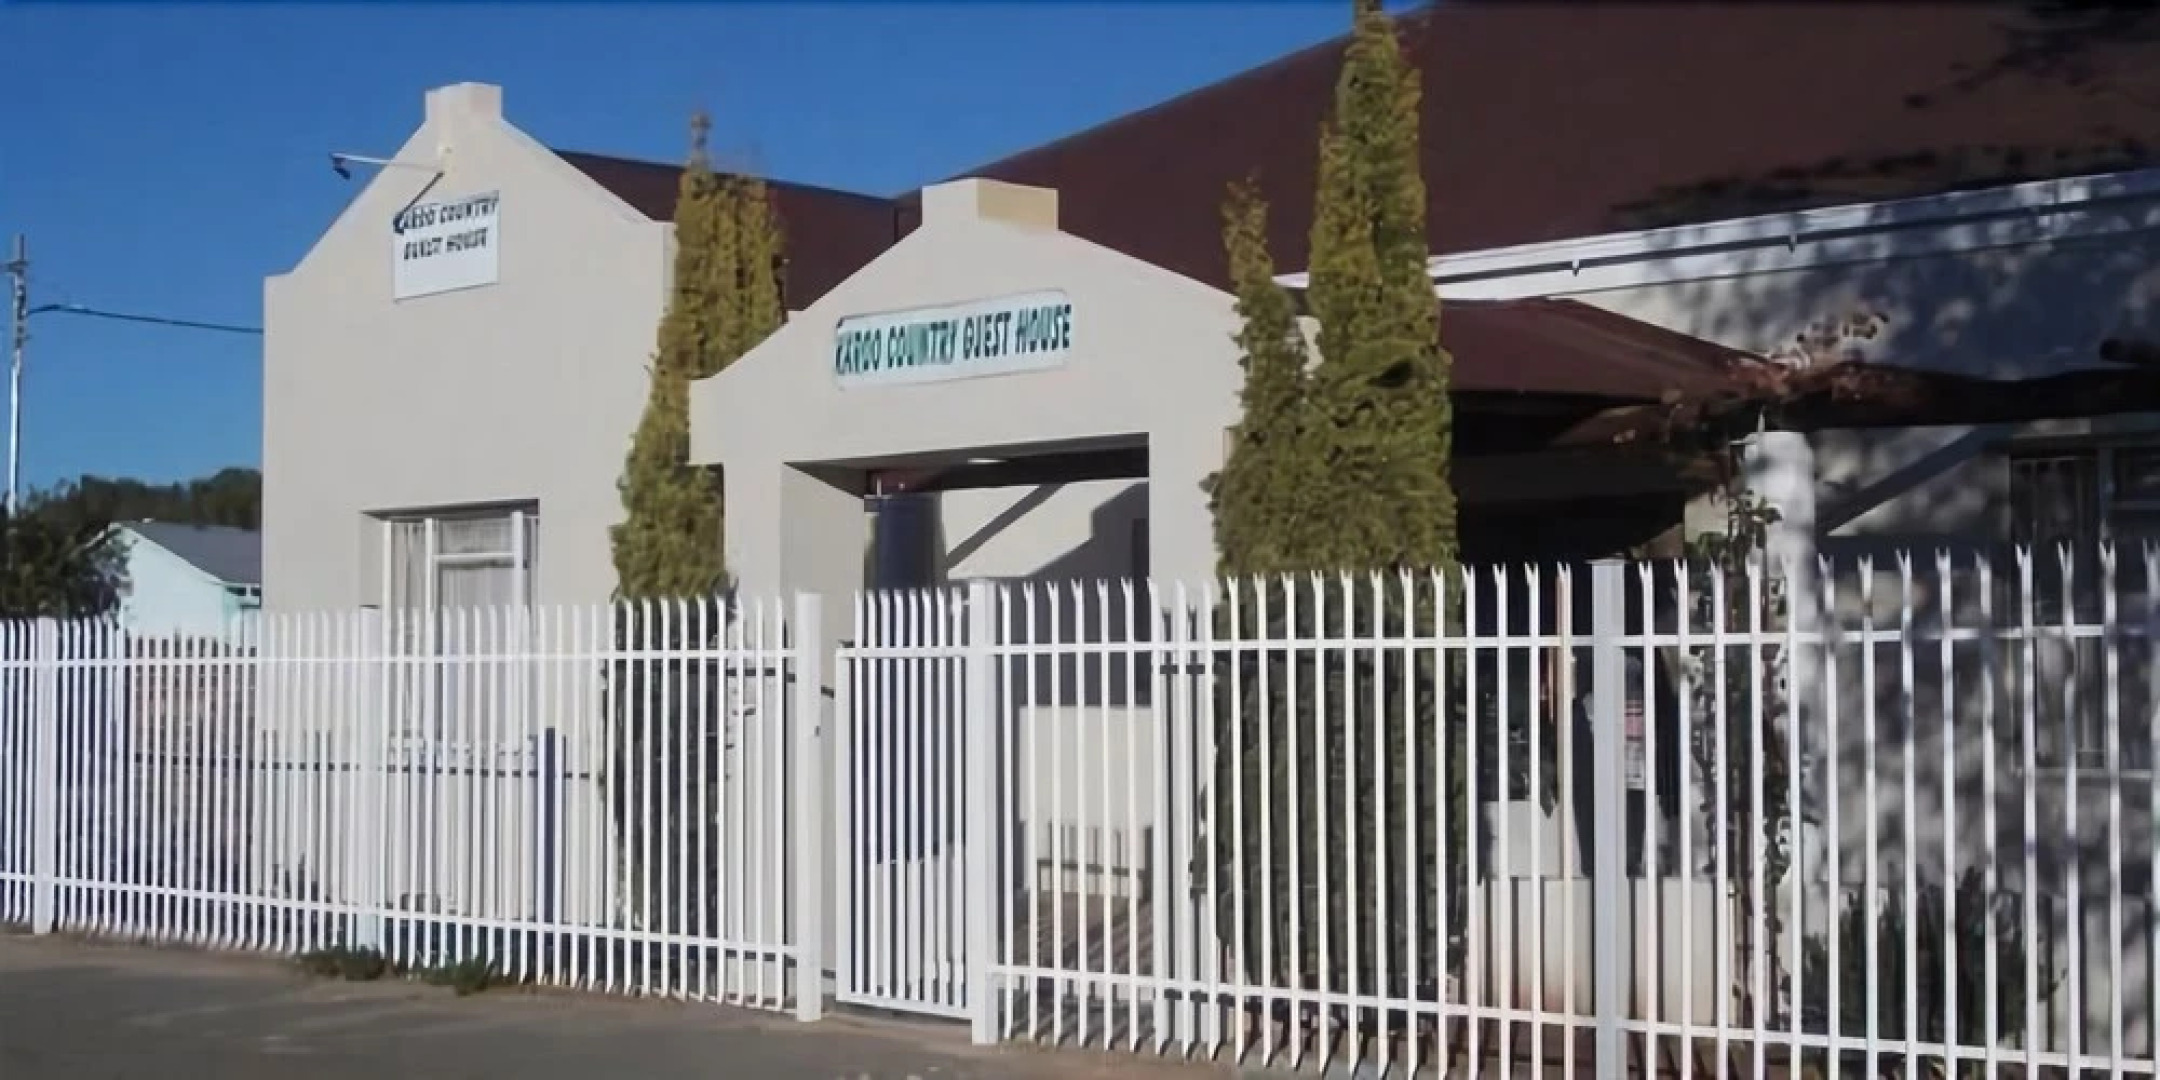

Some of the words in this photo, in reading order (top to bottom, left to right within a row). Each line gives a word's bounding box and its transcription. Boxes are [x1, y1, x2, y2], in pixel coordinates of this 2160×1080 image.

[835, 327, 882, 376] KAROO
[887, 320, 960, 370] COUNTRY
[962, 310, 1012, 361] GUEST
[1014, 303, 1072, 354] HOUSE
